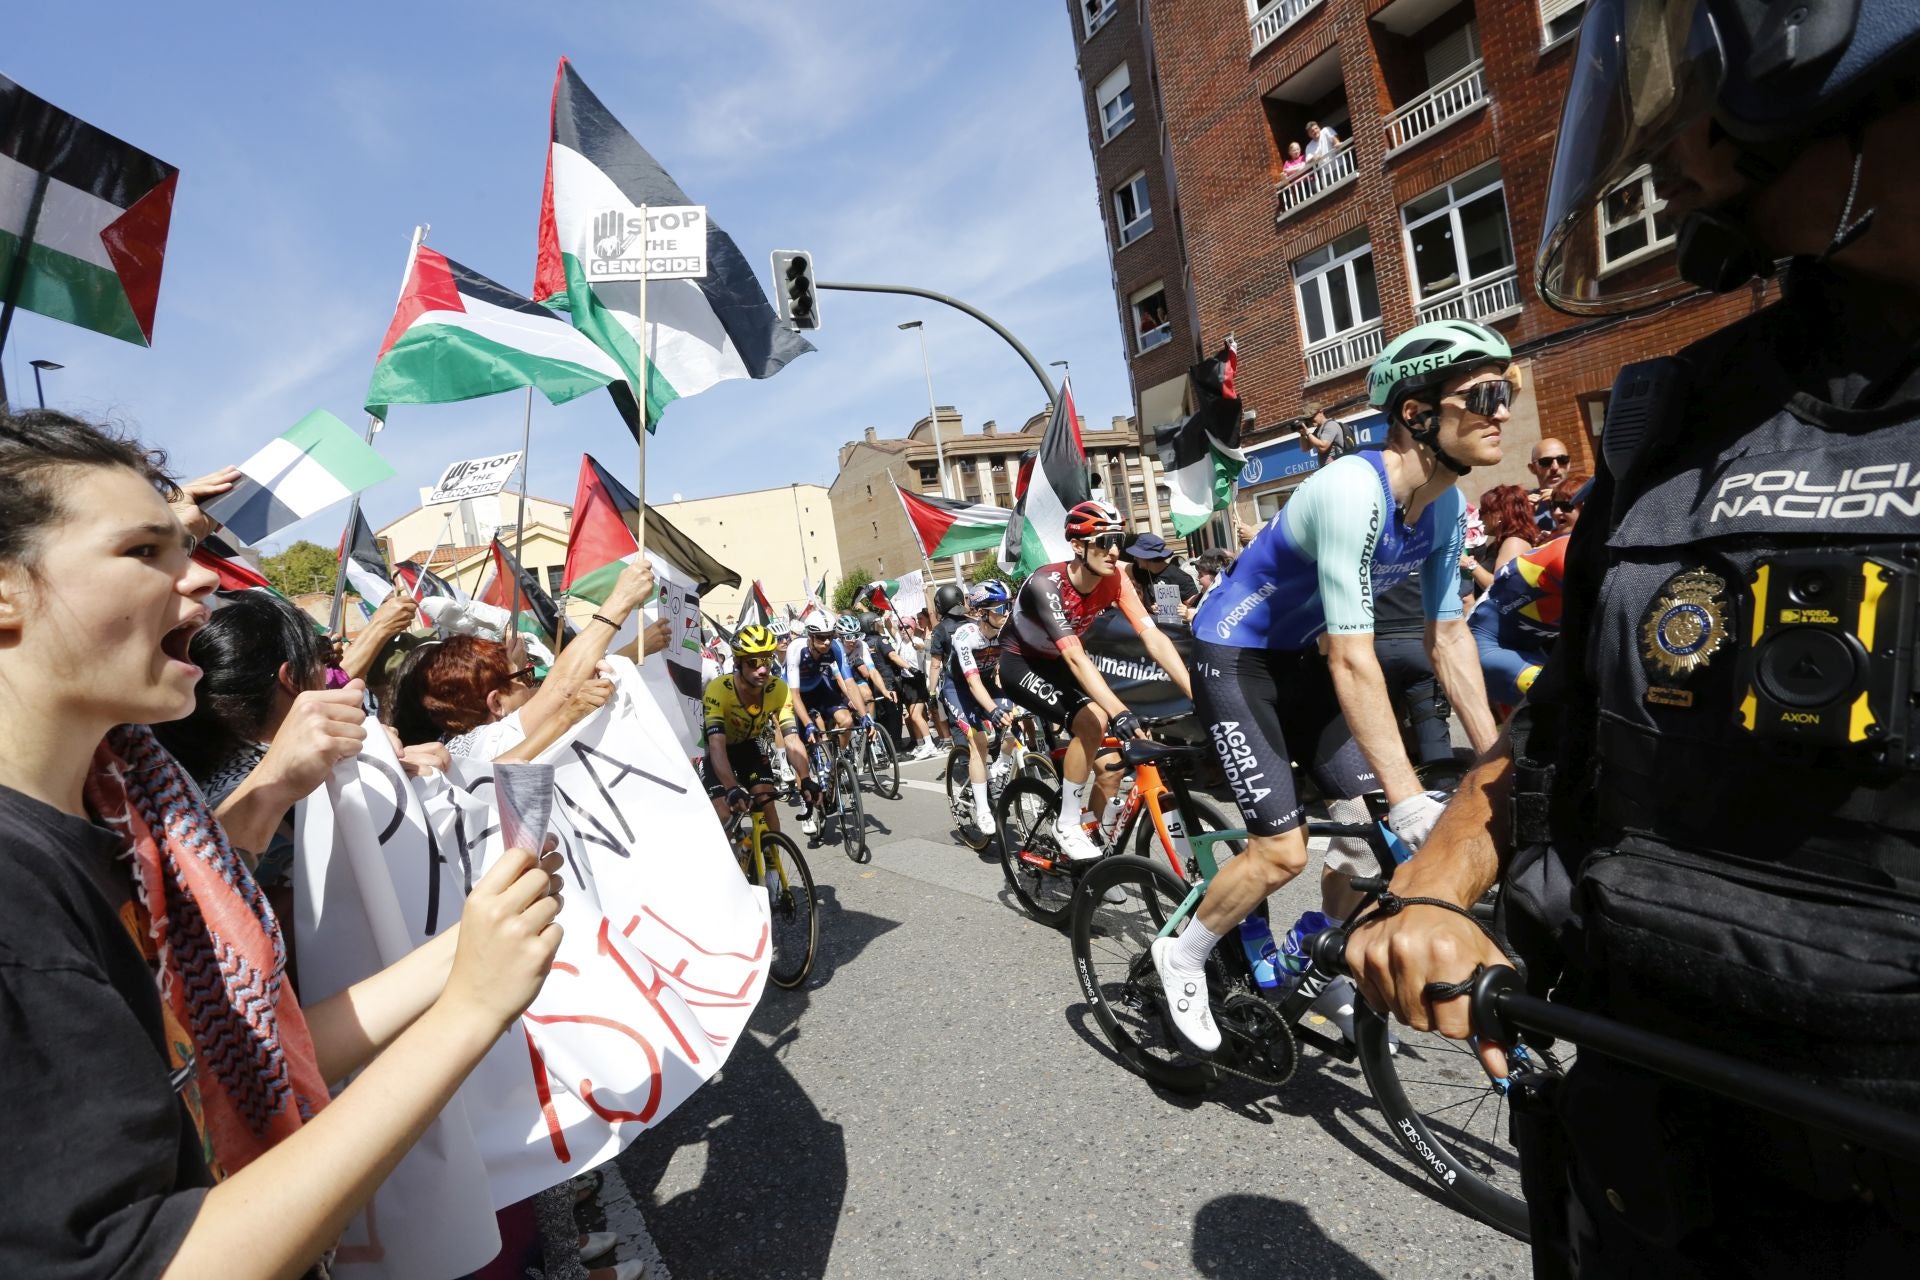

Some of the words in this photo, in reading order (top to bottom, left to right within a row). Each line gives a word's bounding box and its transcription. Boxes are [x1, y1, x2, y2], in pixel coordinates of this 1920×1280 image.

[626, 210, 700, 235] STOP
[645, 239, 677, 251] THE
[591, 257, 700, 274] GENOCIDE
[468, 454, 518, 474] STOP
[472, 473, 495, 482] THE
[432, 481, 501, 500] GENOCIDE
[1359, 502, 1380, 597] DECATHLON
[1046, 592, 1073, 631] INEOS
[1227, 582, 1278, 628] DECATHLON
[1801, 609, 1830, 617] VIDEO
[1809, 616, 1839, 624] AUDIO
[961, 646, 972, 666] BOSS
[1019, 671, 1063, 706] INEOS
[1781, 712, 1820, 724] AXON
[1210, 723, 1258, 820] MONDIALE
[1220, 721, 1258, 772] AG2R
[1244, 772, 1272, 804] LA
[1357, 773, 1375, 781] VAN
[1167, 822, 1185, 839] 97
[1269, 815, 1290, 827] VAN
[1398, 1118, 1419, 1144] SIDE
[1415, 1140, 1447, 1174] SWISS
